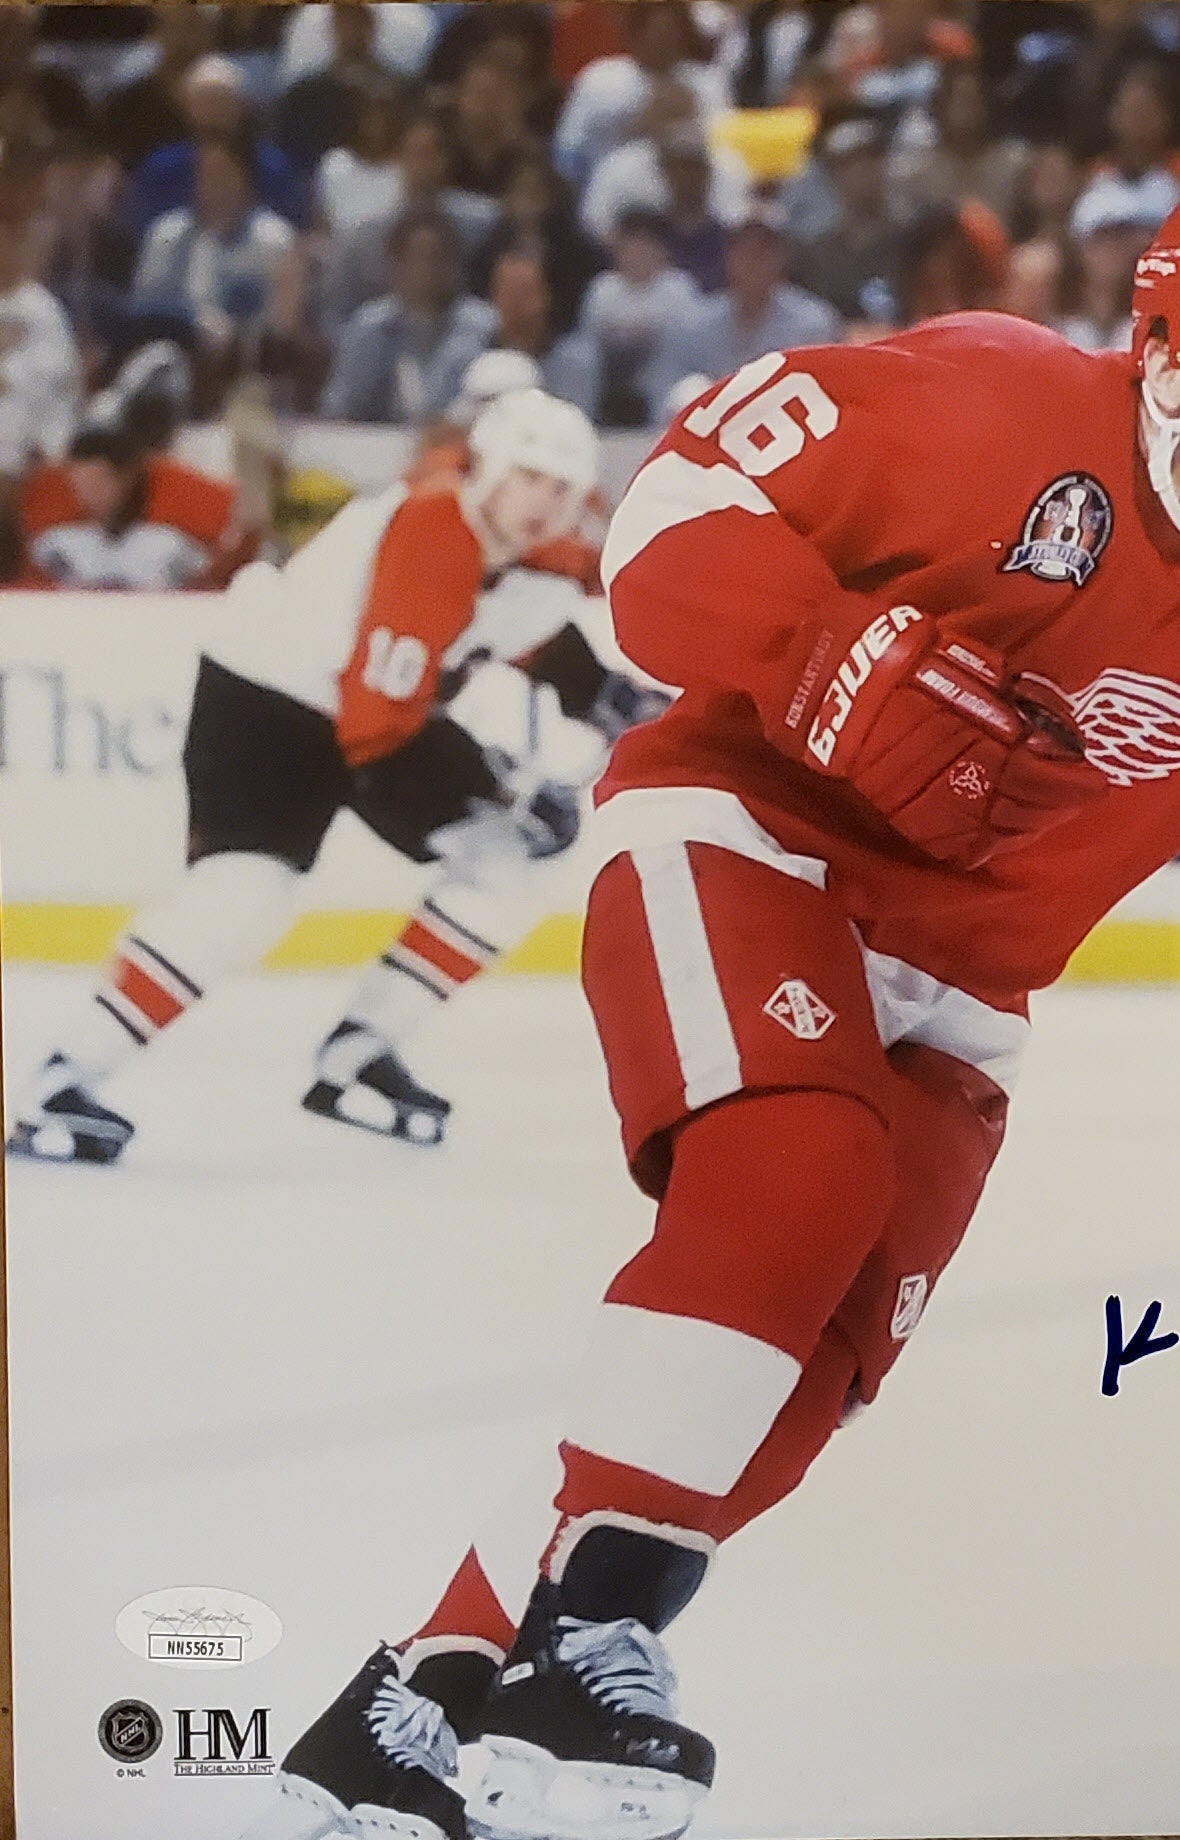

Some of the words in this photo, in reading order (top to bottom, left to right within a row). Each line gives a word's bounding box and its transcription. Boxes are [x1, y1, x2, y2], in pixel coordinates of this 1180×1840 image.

[684, 352, 839, 477] 16
[167, 1640, 224, 1656] NN55675
[120, 1717, 143, 1744] NHL
[172, 1708, 271, 1760] HM
